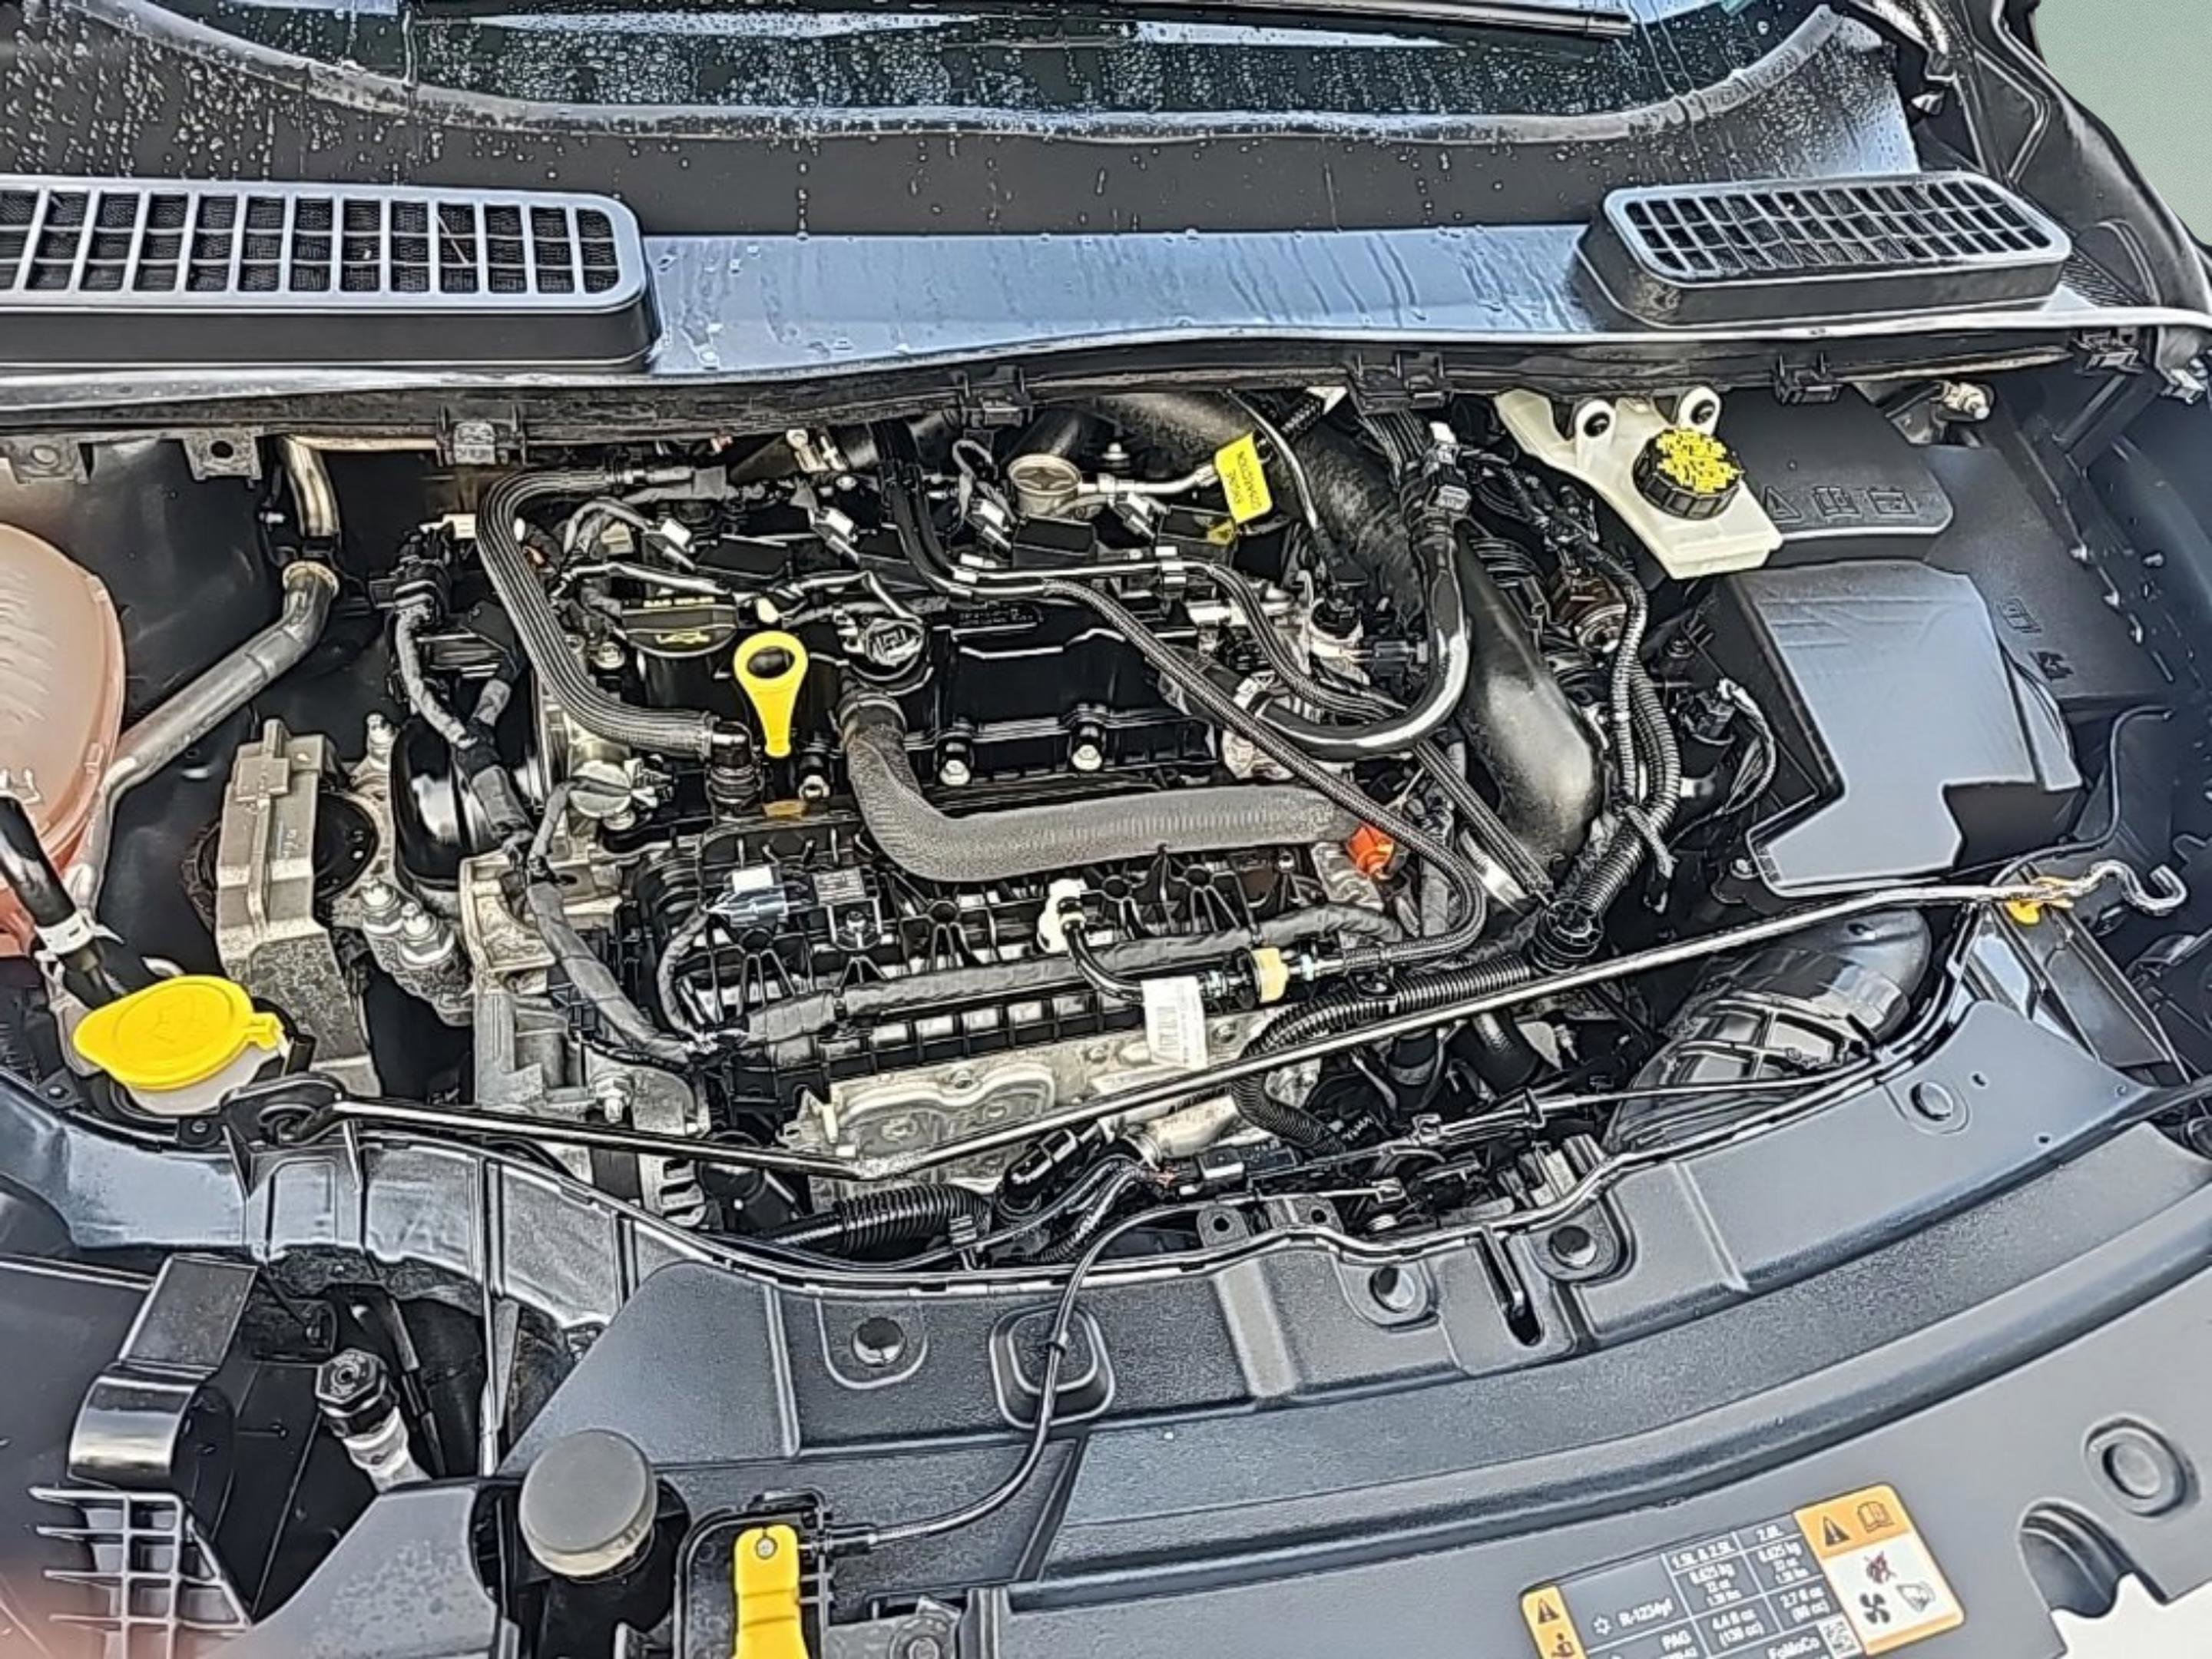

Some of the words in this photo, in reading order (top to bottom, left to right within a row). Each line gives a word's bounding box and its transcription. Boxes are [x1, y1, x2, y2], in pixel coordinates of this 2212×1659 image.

[1618, 1598, 1673, 1627] R-1234yf
[1662, 1630, 1692, 1651] PAG
[1768, 1637, 1820, 1659] FoMoCo
